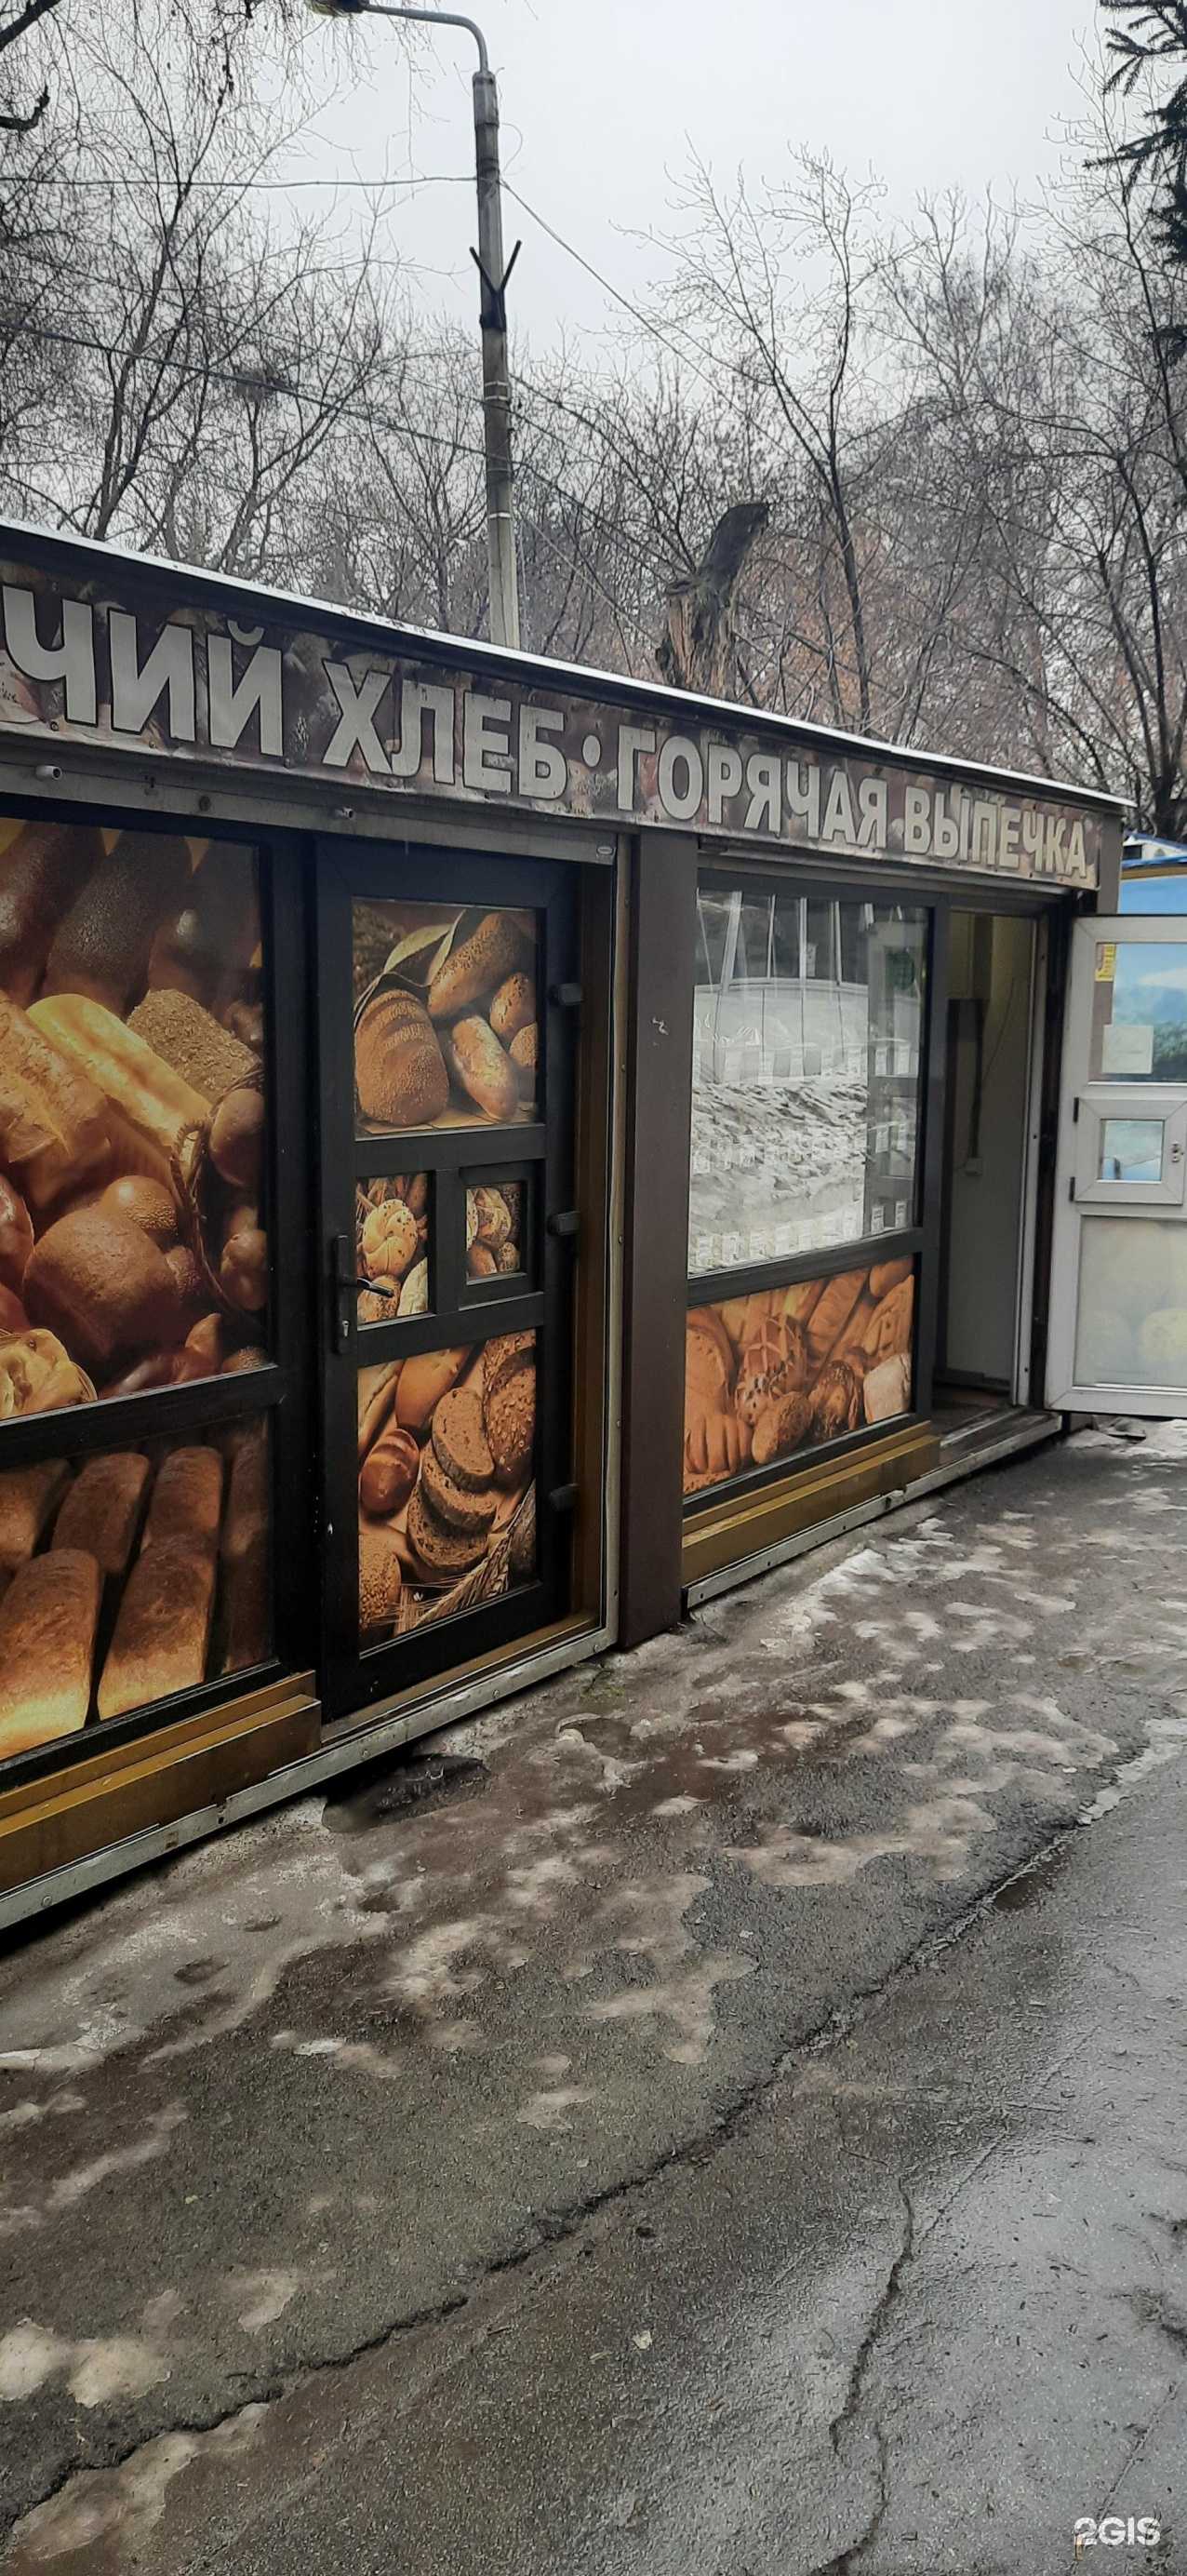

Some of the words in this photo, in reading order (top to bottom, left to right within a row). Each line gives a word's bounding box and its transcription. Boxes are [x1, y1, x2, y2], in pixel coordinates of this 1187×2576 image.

[2, 584, 284, 757] ЧИЙ
[322, 657, 568, 800] ХЛЕБ
[617, 724, 888, 849] ГОРЯЧАЯ
[903, 785, 1088, 879] ВЫПЕЧКА
